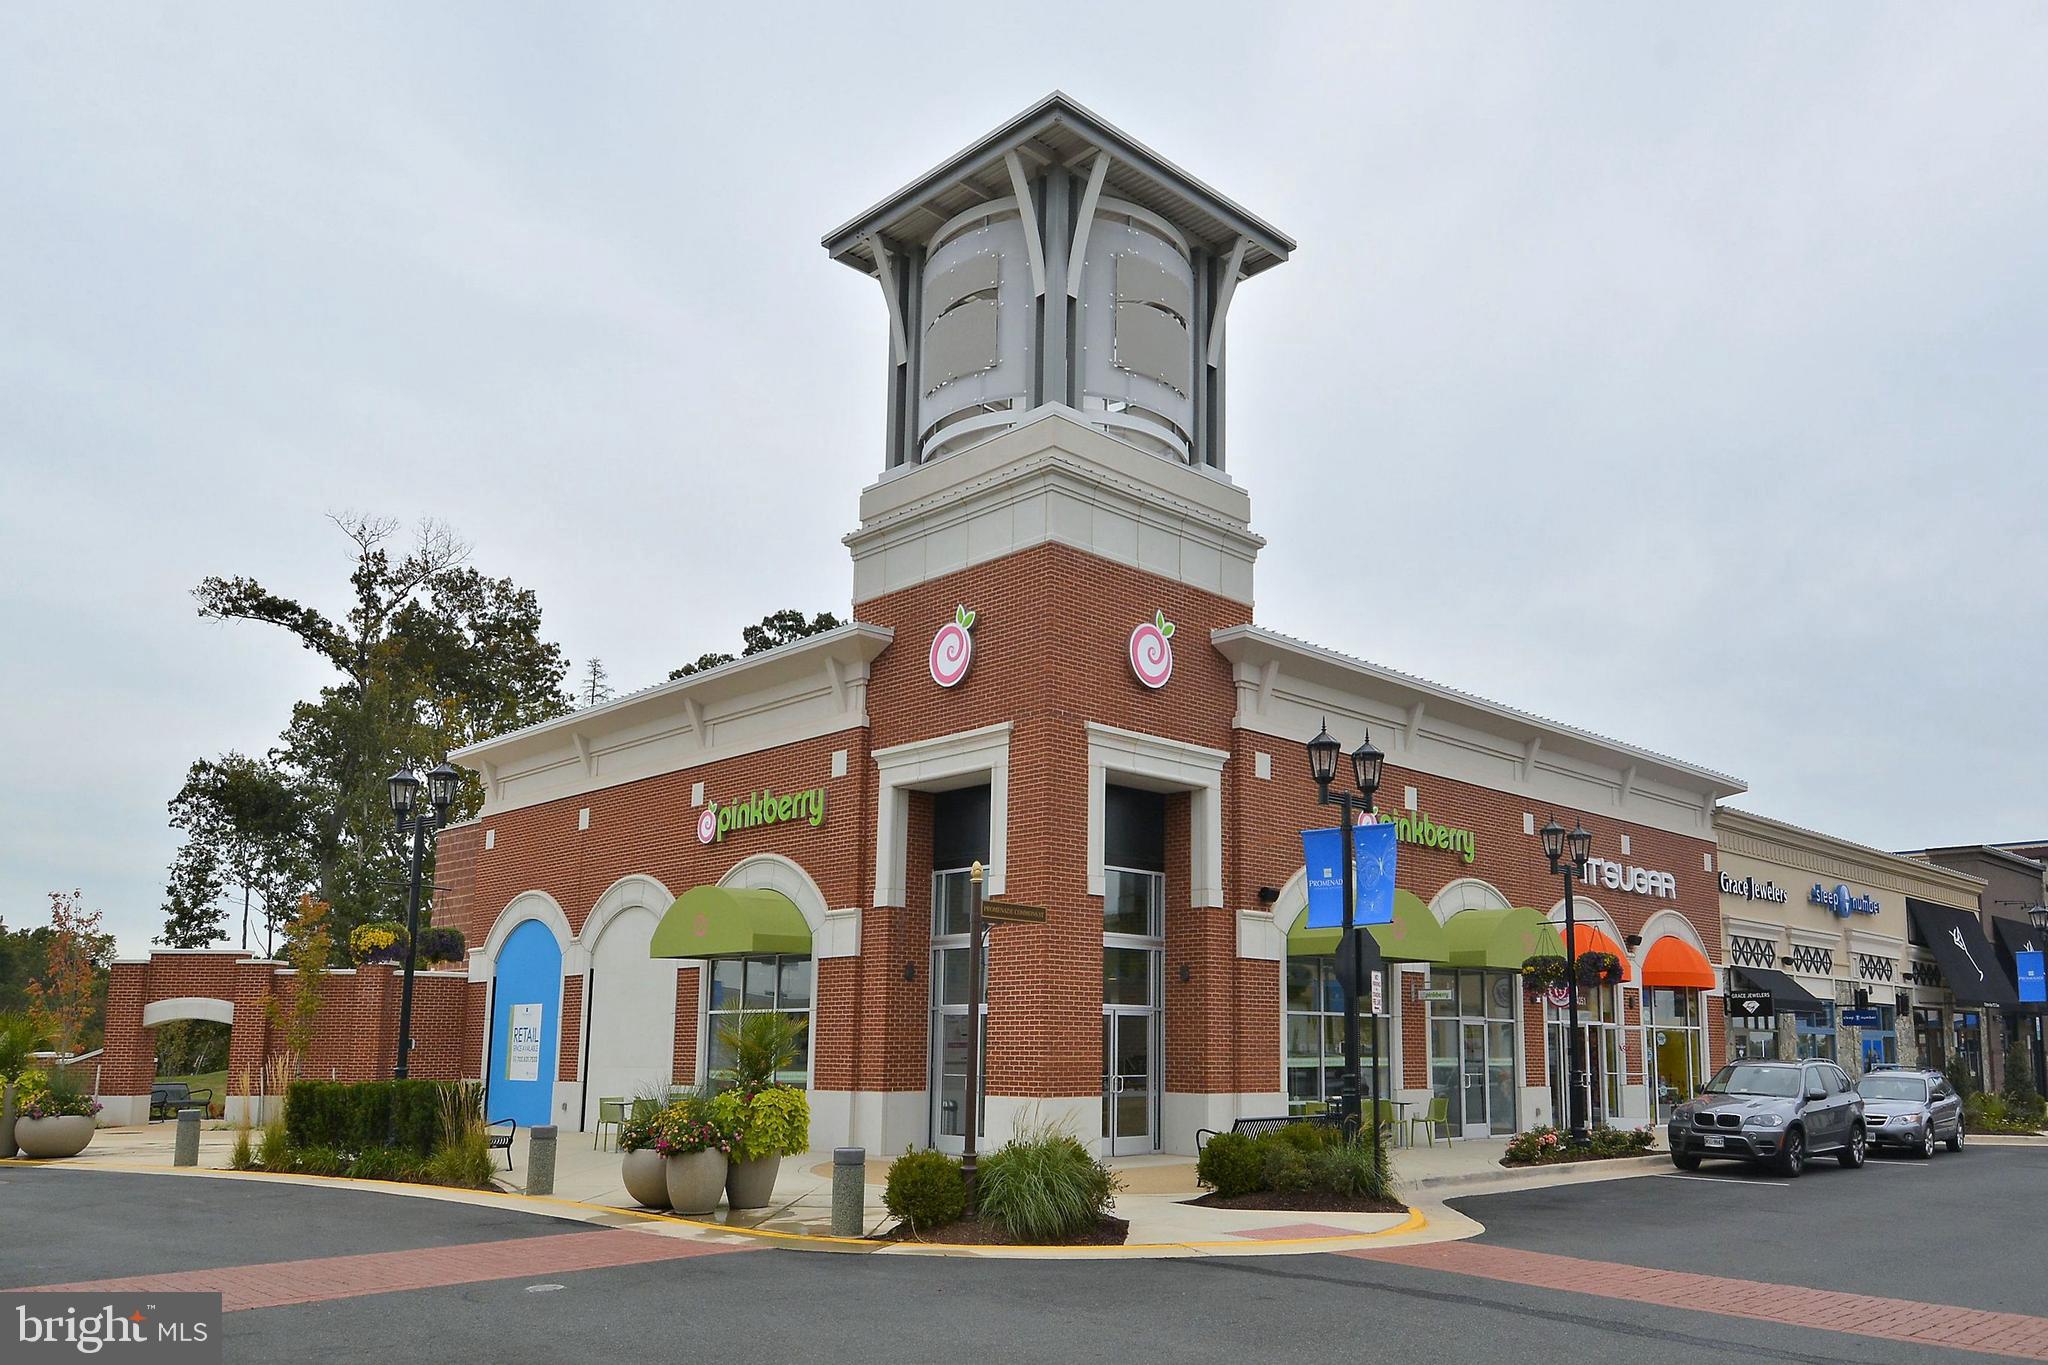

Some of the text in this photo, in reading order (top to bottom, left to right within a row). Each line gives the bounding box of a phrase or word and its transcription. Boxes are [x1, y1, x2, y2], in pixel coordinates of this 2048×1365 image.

[717, 788, 826, 842] pinkberry
[1380, 808, 1476, 864] inkberry
[1308, 879, 1344, 888] PROMENAD
[1720, 871, 1788, 904] Grace Jewelers
[1815, 883, 1881, 915] sleep number
[513, 1027, 539, 1043] RETAIL
